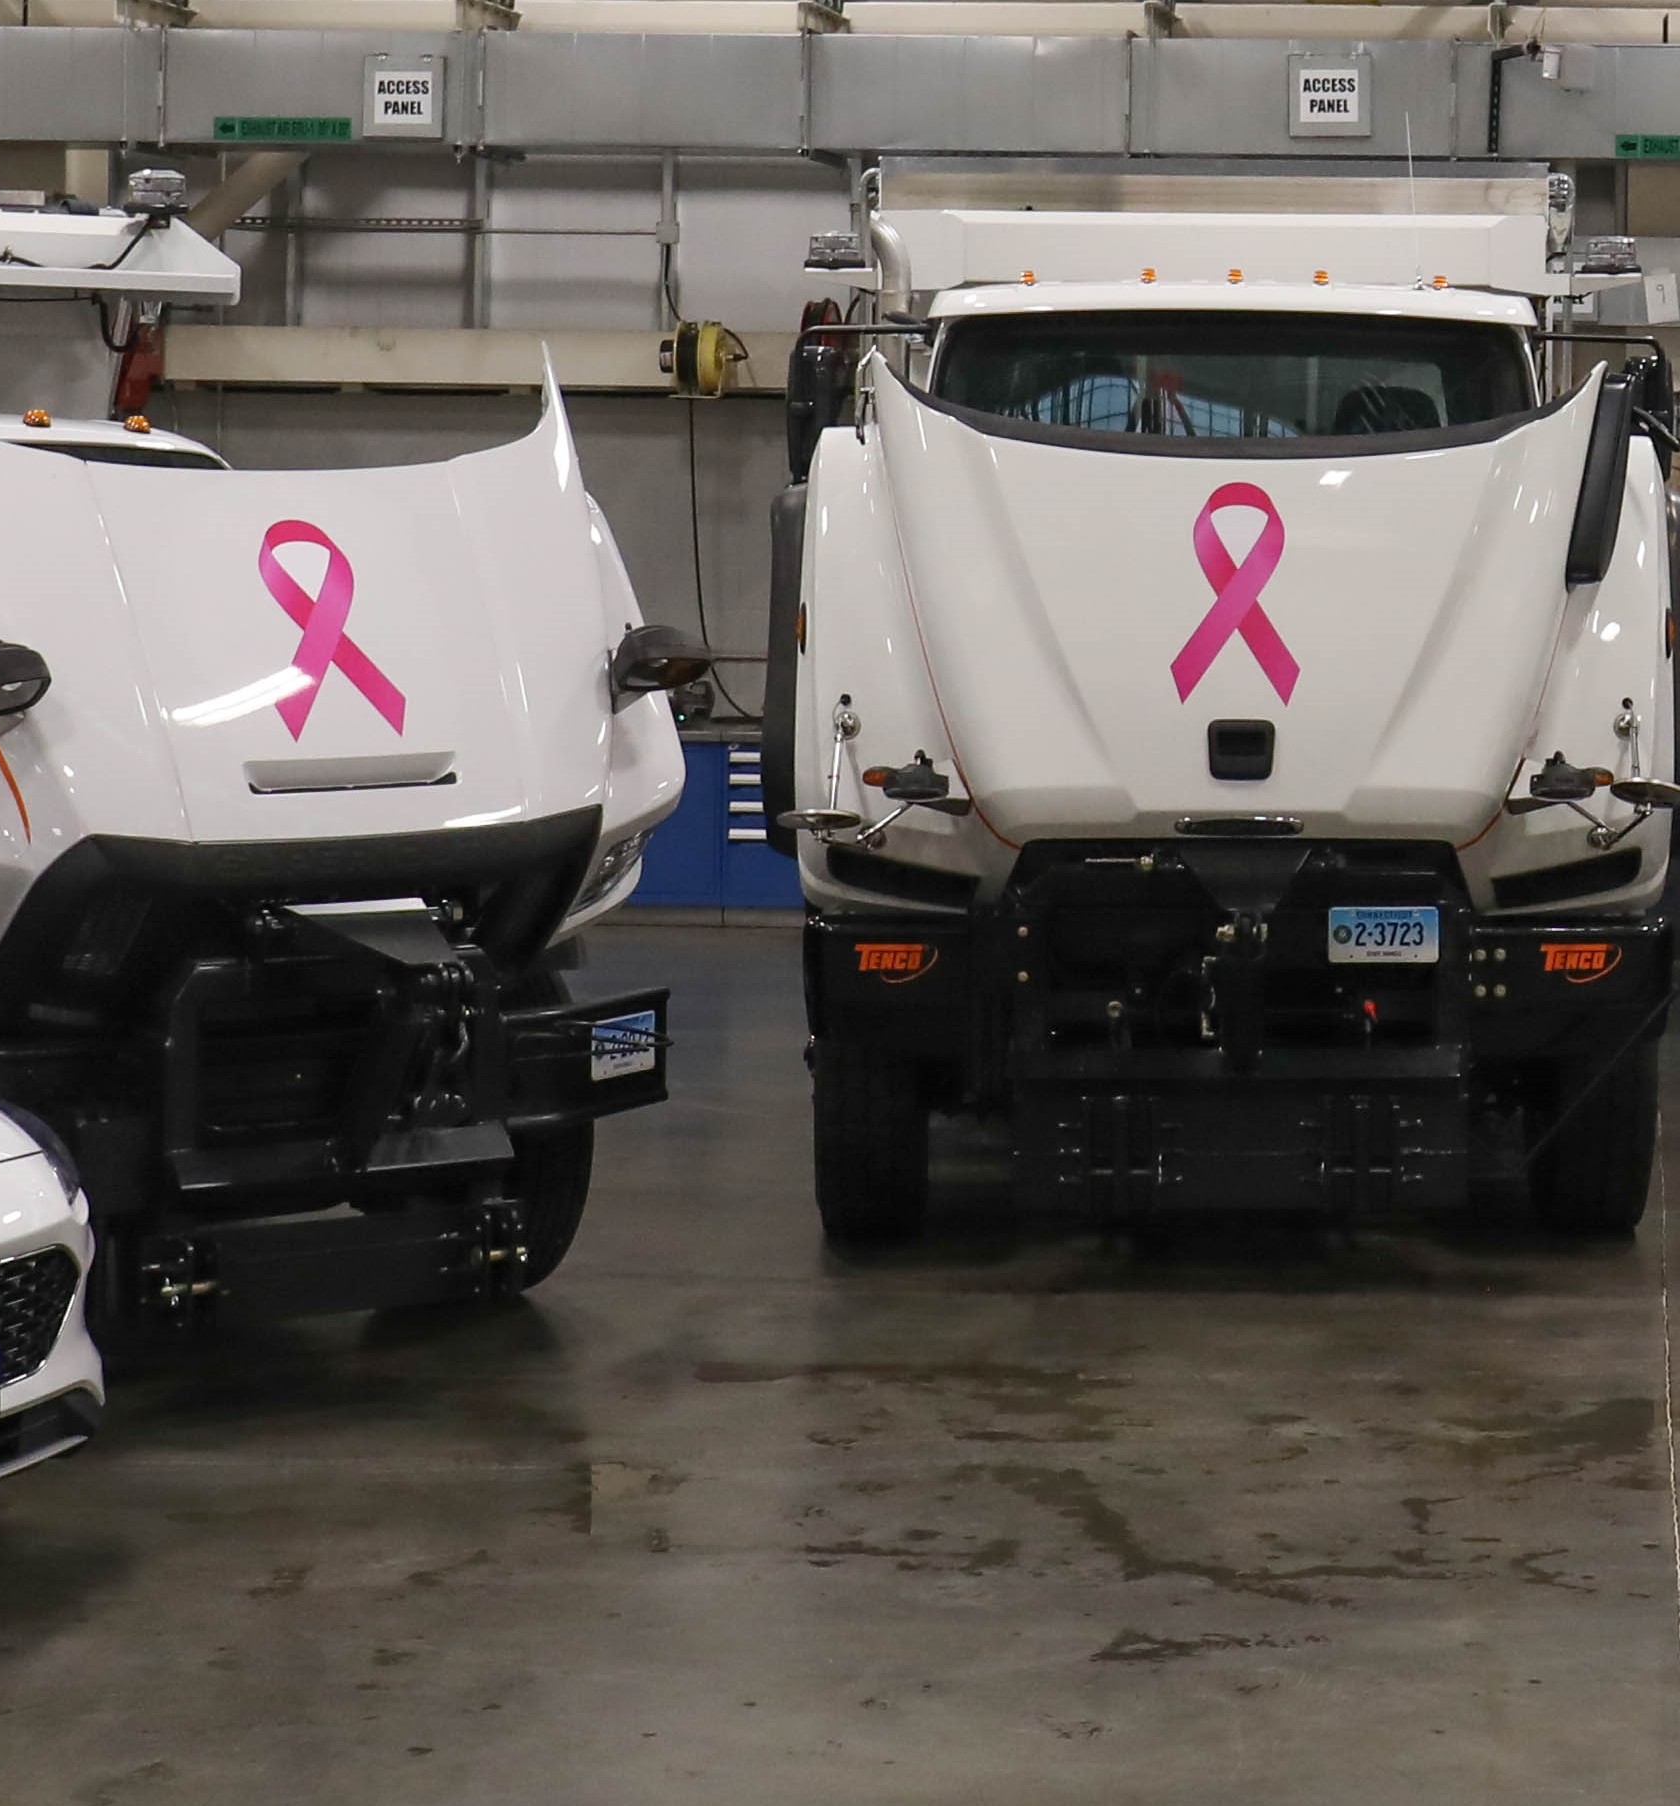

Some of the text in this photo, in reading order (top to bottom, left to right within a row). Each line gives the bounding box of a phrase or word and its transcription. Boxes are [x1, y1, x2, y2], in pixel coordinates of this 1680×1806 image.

[377, 80, 429, 95] ACCESS
[1303, 78, 1356, 93] ACCESS
[383, 101, 423, 115] PANEL
[1309, 99, 1350, 113] PANEL
[854, 943, 923, 971] TENCO
[1540, 943, 1608, 971] TENCO
